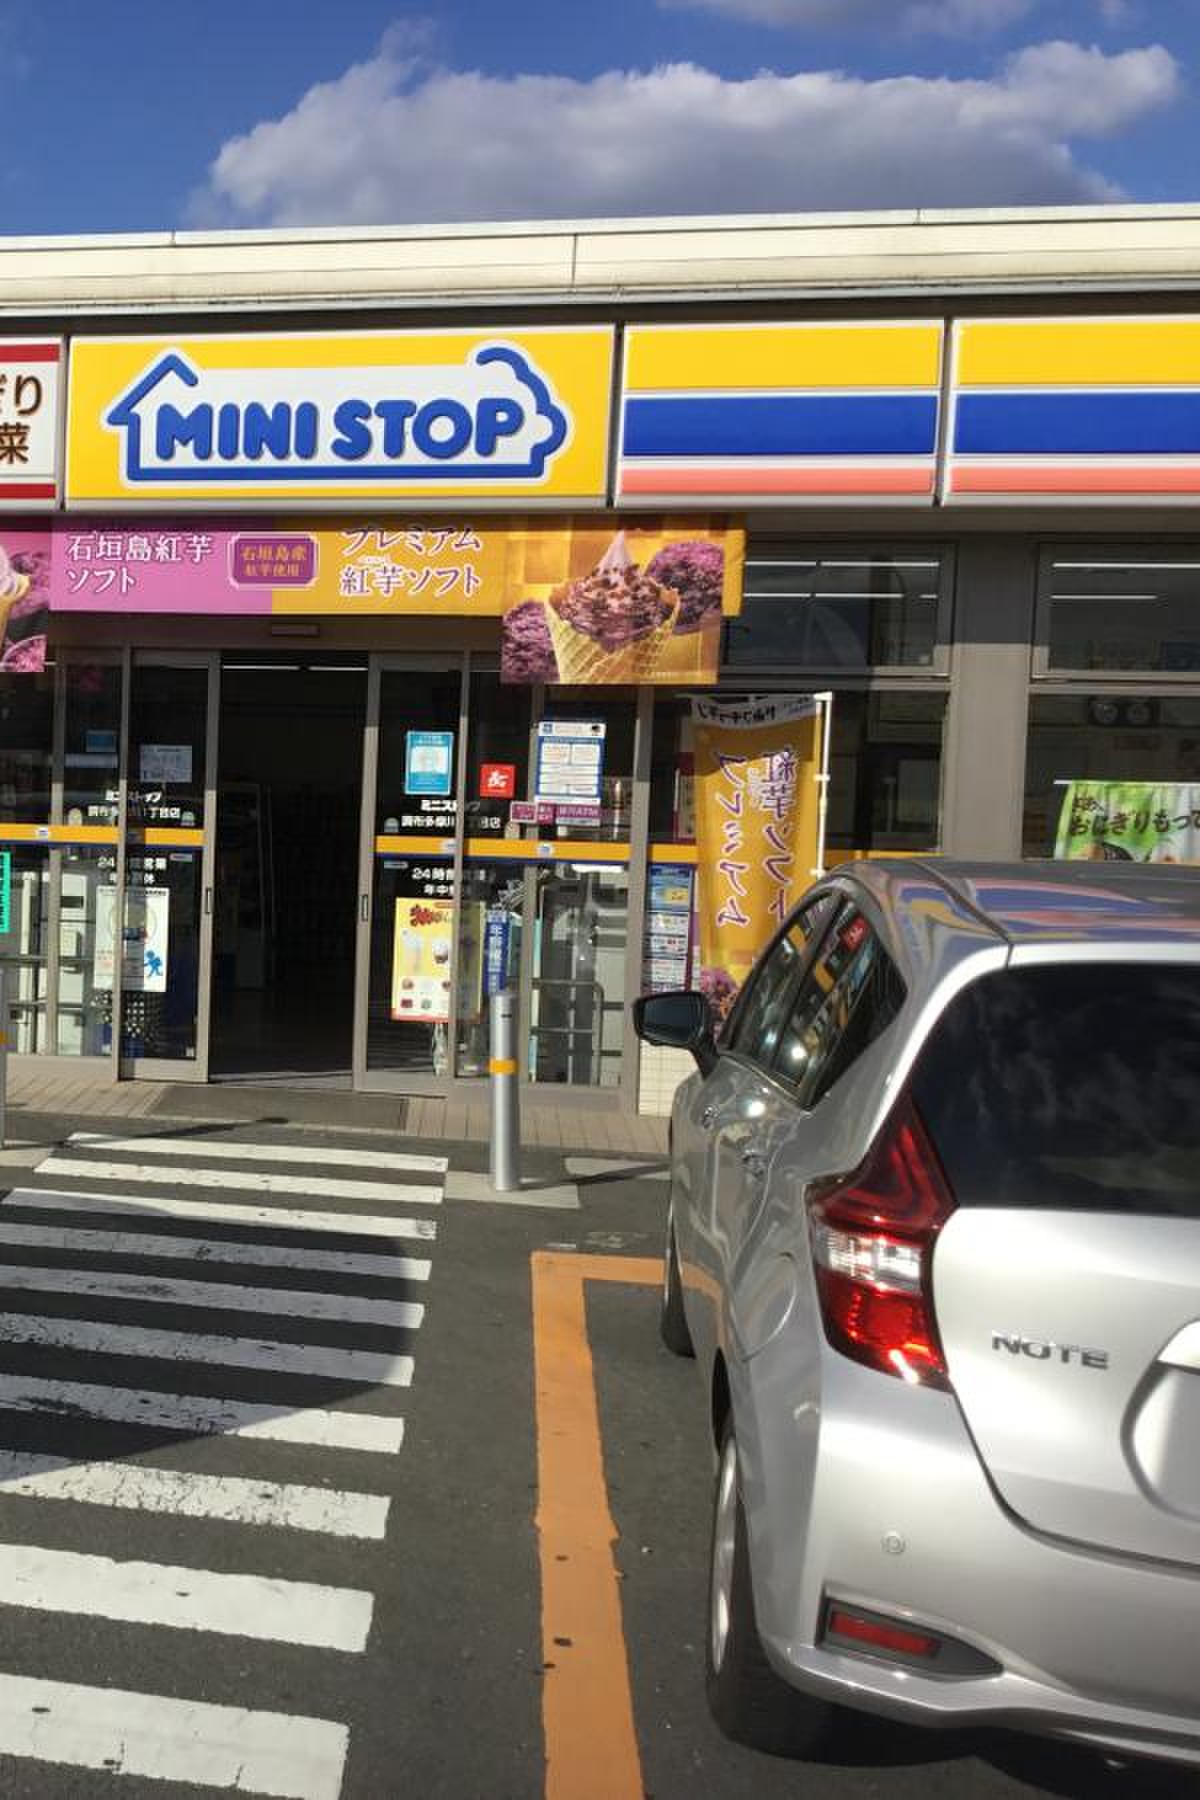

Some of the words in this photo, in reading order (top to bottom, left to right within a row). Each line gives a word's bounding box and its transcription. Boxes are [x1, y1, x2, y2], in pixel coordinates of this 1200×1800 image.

[156, 401, 320, 461] MINI
[331, 398, 526, 460] STOP
[68, 535, 213, 563] 石垣島紅芋
[343, 524, 481, 555] プレミアム
[68, 567, 136, 593] ソフト
[341, 565, 482, 596] 紅芋ソフト
[992, 1336, 1109, 1370] NOTE
